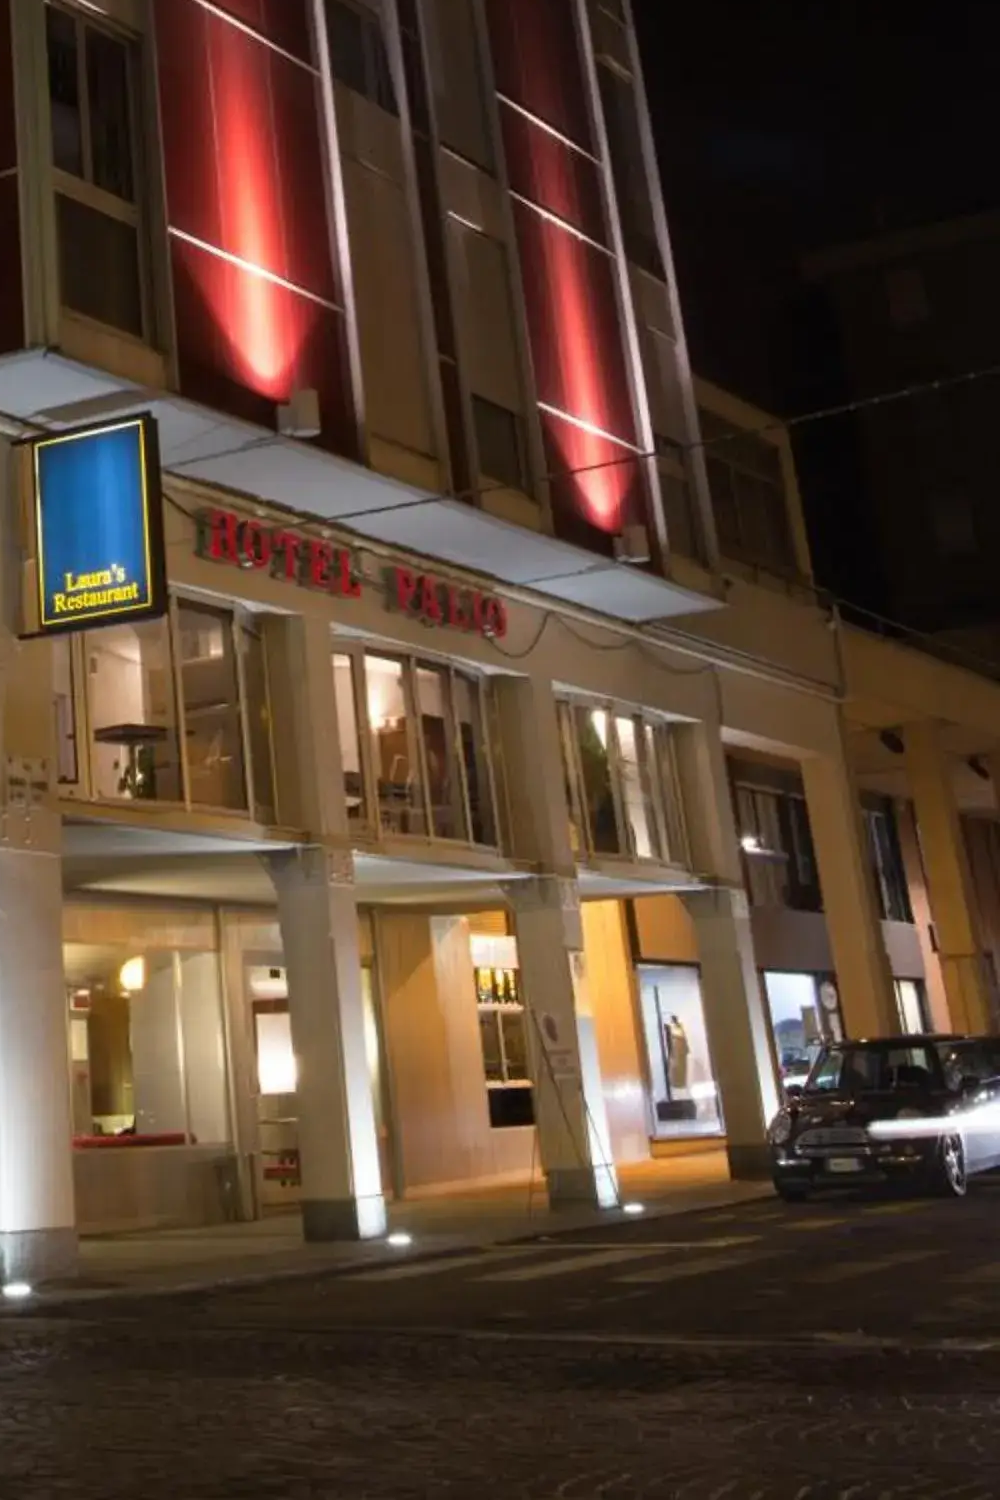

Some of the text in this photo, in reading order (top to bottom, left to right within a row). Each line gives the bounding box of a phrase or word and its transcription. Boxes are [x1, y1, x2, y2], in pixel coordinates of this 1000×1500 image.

[64, 563, 126, 592] Laura's
[199, 508, 507, 639] HOTEL PALIO
[53, 582, 138, 613] Restaurant
